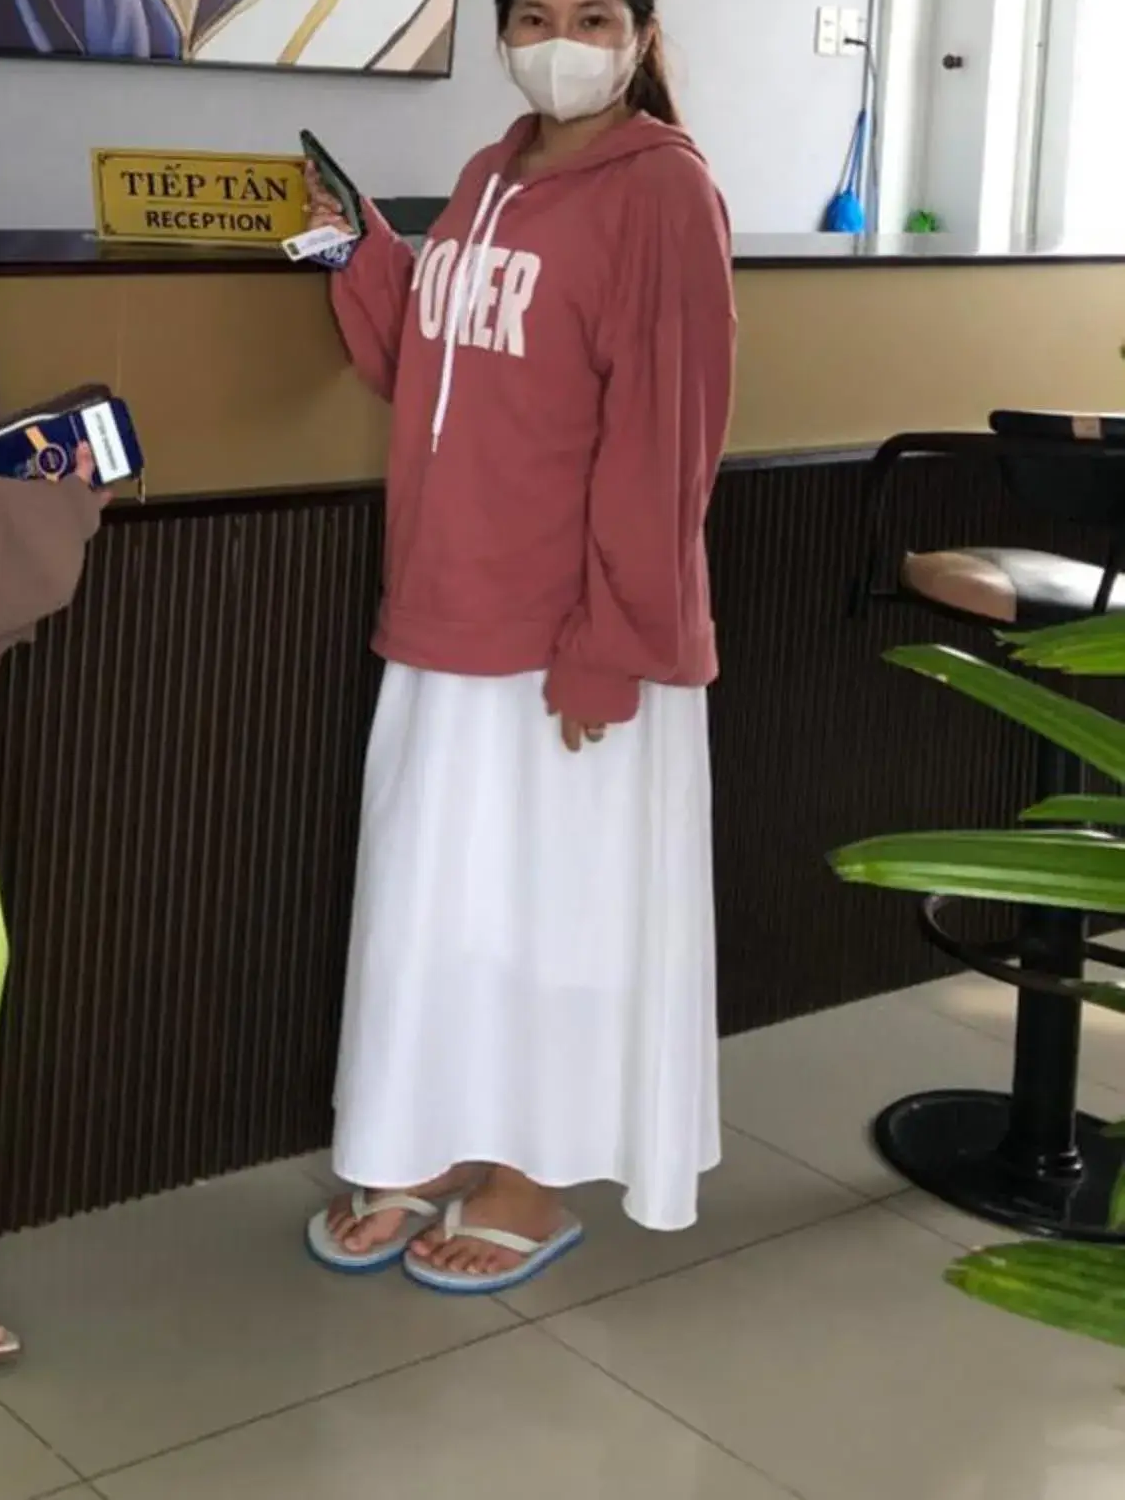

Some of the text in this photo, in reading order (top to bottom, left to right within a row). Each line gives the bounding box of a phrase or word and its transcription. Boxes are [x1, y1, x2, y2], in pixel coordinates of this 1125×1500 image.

[120, 163, 288, 201] TIẾP TÂN
[145, 210, 272, 232] RECEPTION
